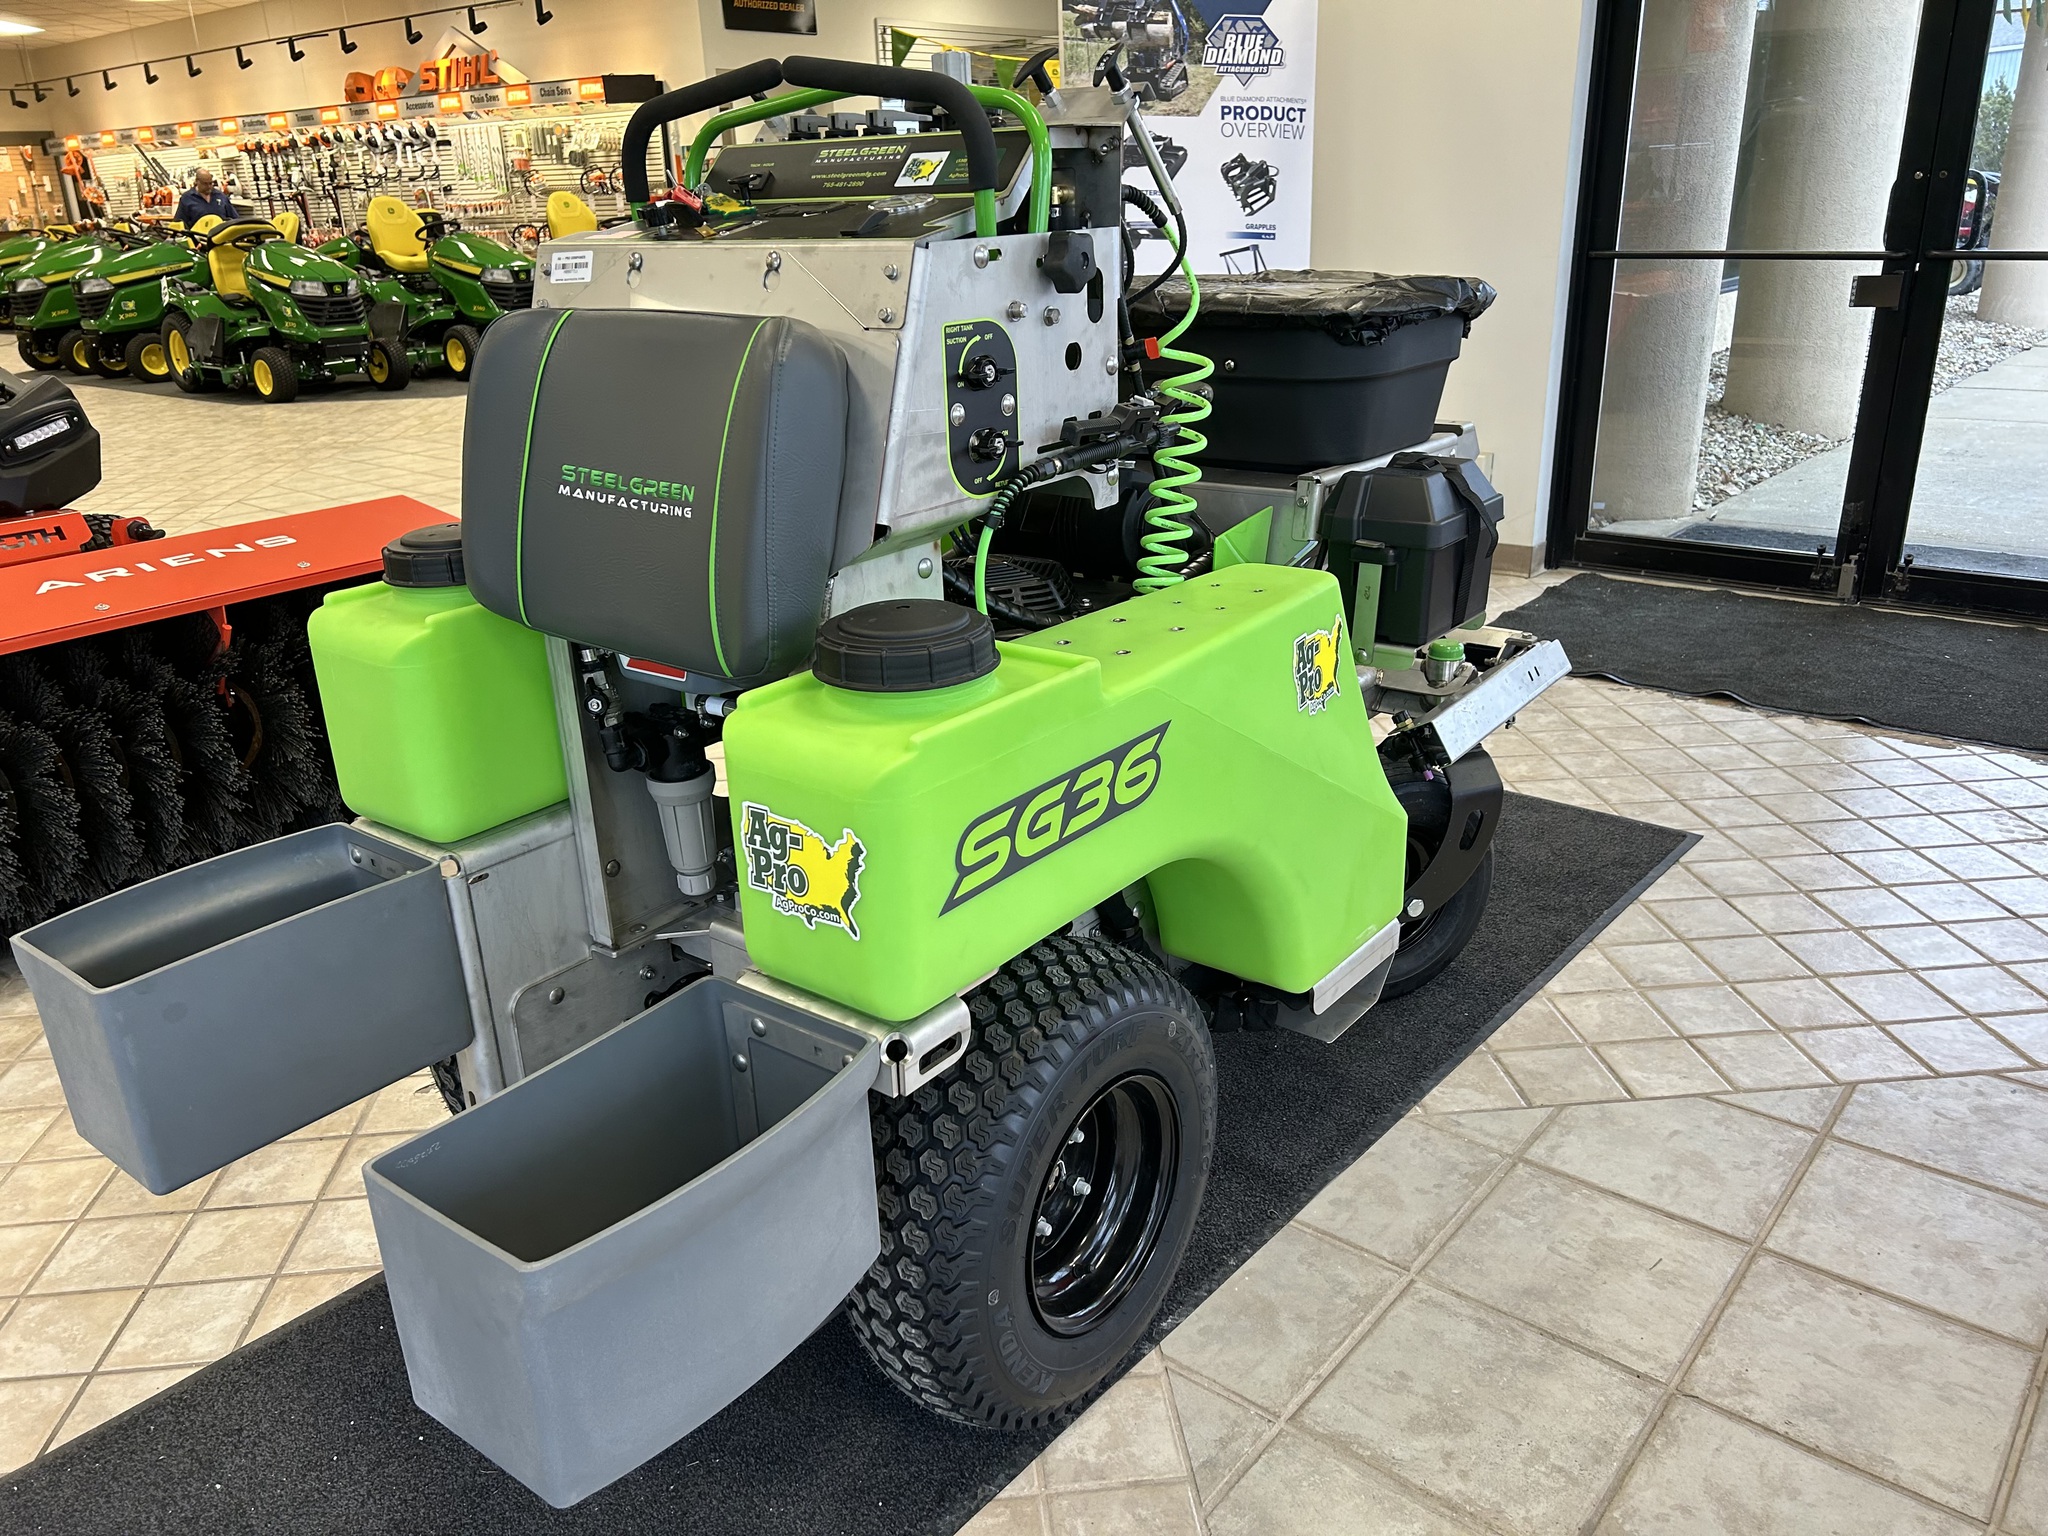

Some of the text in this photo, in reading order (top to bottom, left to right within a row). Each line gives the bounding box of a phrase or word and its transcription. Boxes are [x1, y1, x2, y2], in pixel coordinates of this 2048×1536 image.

[733, 0, 805, 12] AUTHORIZED DEALER
[1225, 33, 1265, 50] BLUE
[1205, 47, 1283, 65] DIAMOND
[420, 52, 499, 91] STIHL
[1219, 65, 1268, 73] ATTACHMENTS
[470, 92, 500, 104] Chain Saws
[540, 86, 572, 98] Chain Saws
[1236, 95, 1266, 103] DIAMOND
[405, 100, 434, 111] Accessories
[1221, 105, 1307, 123] PRODUCT
[1221, 122, 1306, 140] OVERVIEW
[814, 154, 902, 164] MANUFACTURING
[945, 324, 974, 334] RIGHT TANK
[946, 337, 968, 345] SUCTION
[561, 464, 696, 503] STEELGREEN
[974, 476, 983, 485] OFF
[557, 484, 693, 518] MANUFACTURING
[35, 534, 298, 595] ARIENS
[1297, 665, 1322, 709] Pro
[947, 732, 1162, 903] SG36
[746, 806, 803, 863] Ag-
[750, 848, 809, 898] Pro
[775, 896, 842, 924] AgProCo.com
[1074, 1019, 1148, 1086] TURF
[1000, 1090, 1069, 1246] SUPER
[991, 1303, 1057, 1395] KENDA
